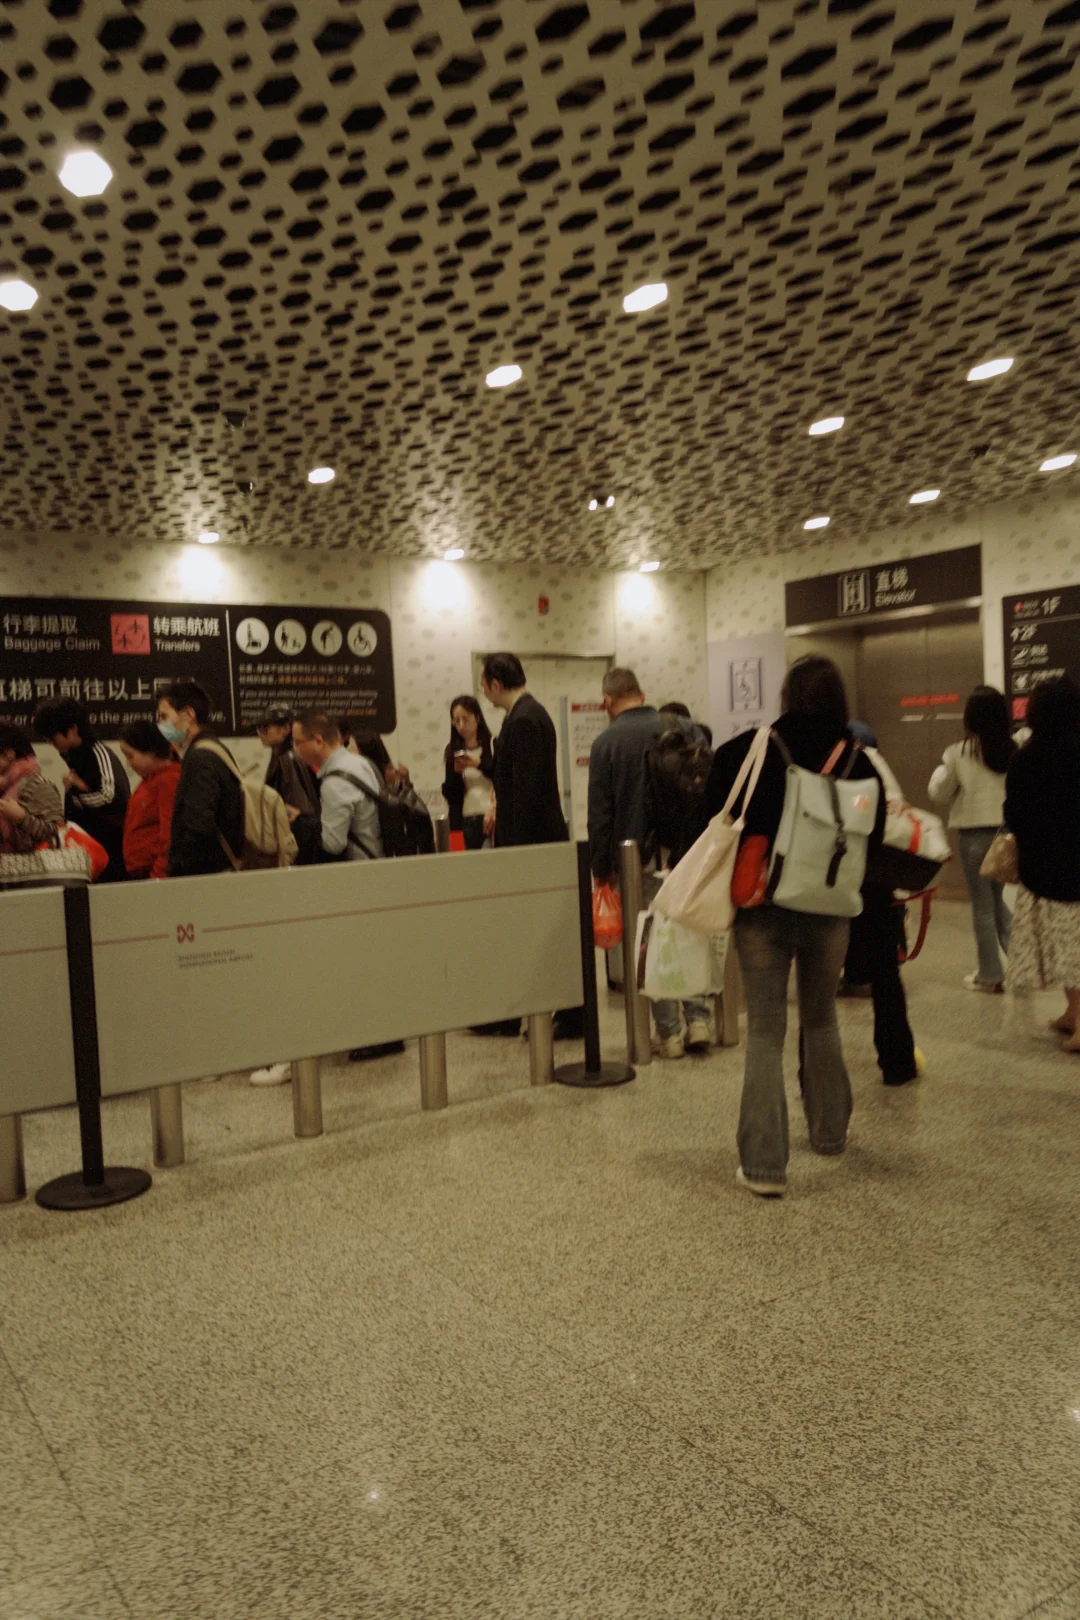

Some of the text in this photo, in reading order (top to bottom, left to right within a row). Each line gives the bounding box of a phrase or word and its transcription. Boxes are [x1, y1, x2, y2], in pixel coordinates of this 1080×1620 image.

[3, 613, 78, 634] 行李提取
[153, 616, 220, 637] 转乘航班
[4, 635, 100, 653] Baggage Claim
[155, 638, 200, 652] Transfers
